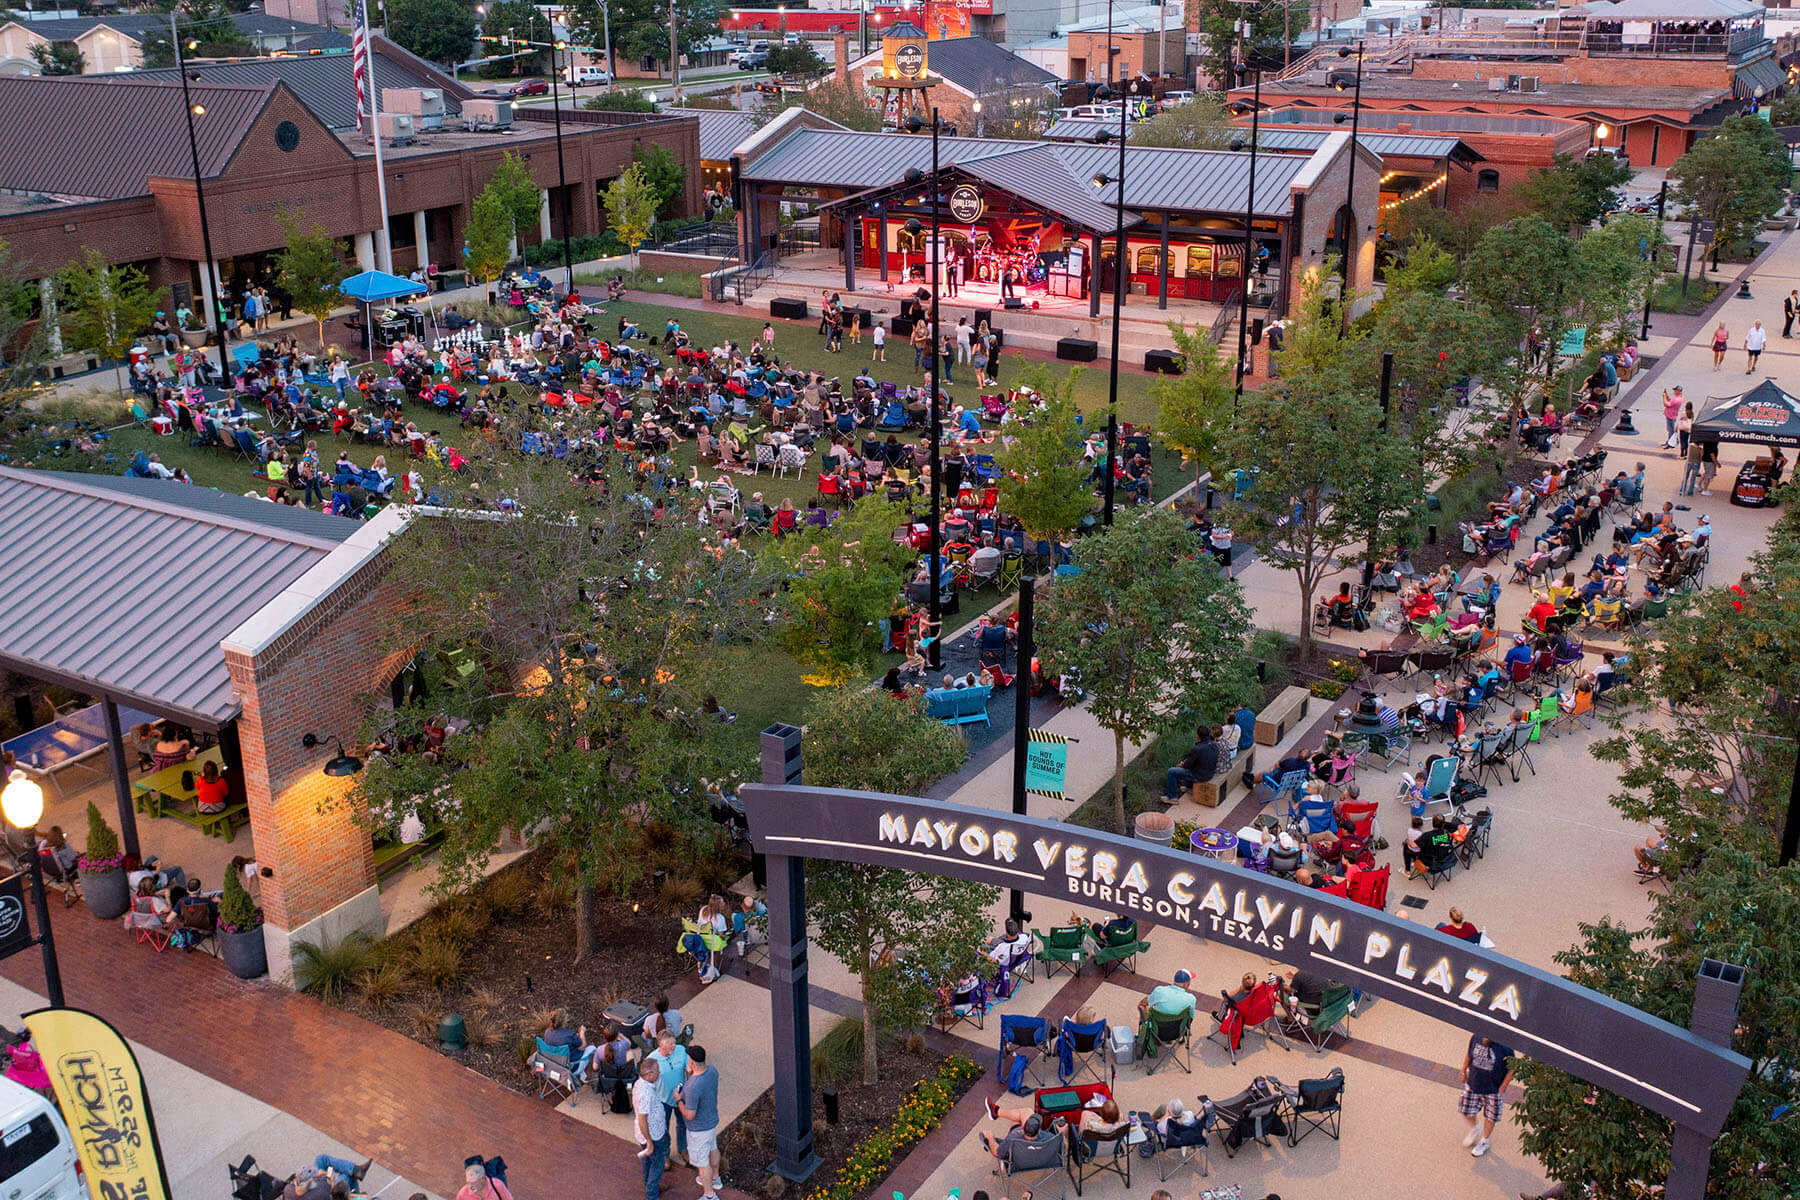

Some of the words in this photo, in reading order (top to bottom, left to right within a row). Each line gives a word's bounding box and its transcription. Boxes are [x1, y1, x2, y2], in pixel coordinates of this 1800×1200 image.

[897, 54, 922, 65] BURLESON
[953, 199, 977, 209] BURLESON
[1718, 431, 1797, 444] 959TheRanch.com
[1029, 755, 1054, 767] SOUNDS
[1040, 751, 1052, 760] HOT
[1032, 763, 1061, 775] SUMMER
[878, 812, 1017, 863] MAYOR
[1032, 838, 1149, 894] VERA
[1166, 872, 1341, 952] CALVIN
[1363, 932, 1519, 1021] PLAZA
[1068, 876, 1200, 929] BURLESON,
[1209, 914, 1286, 951] TEXAS
